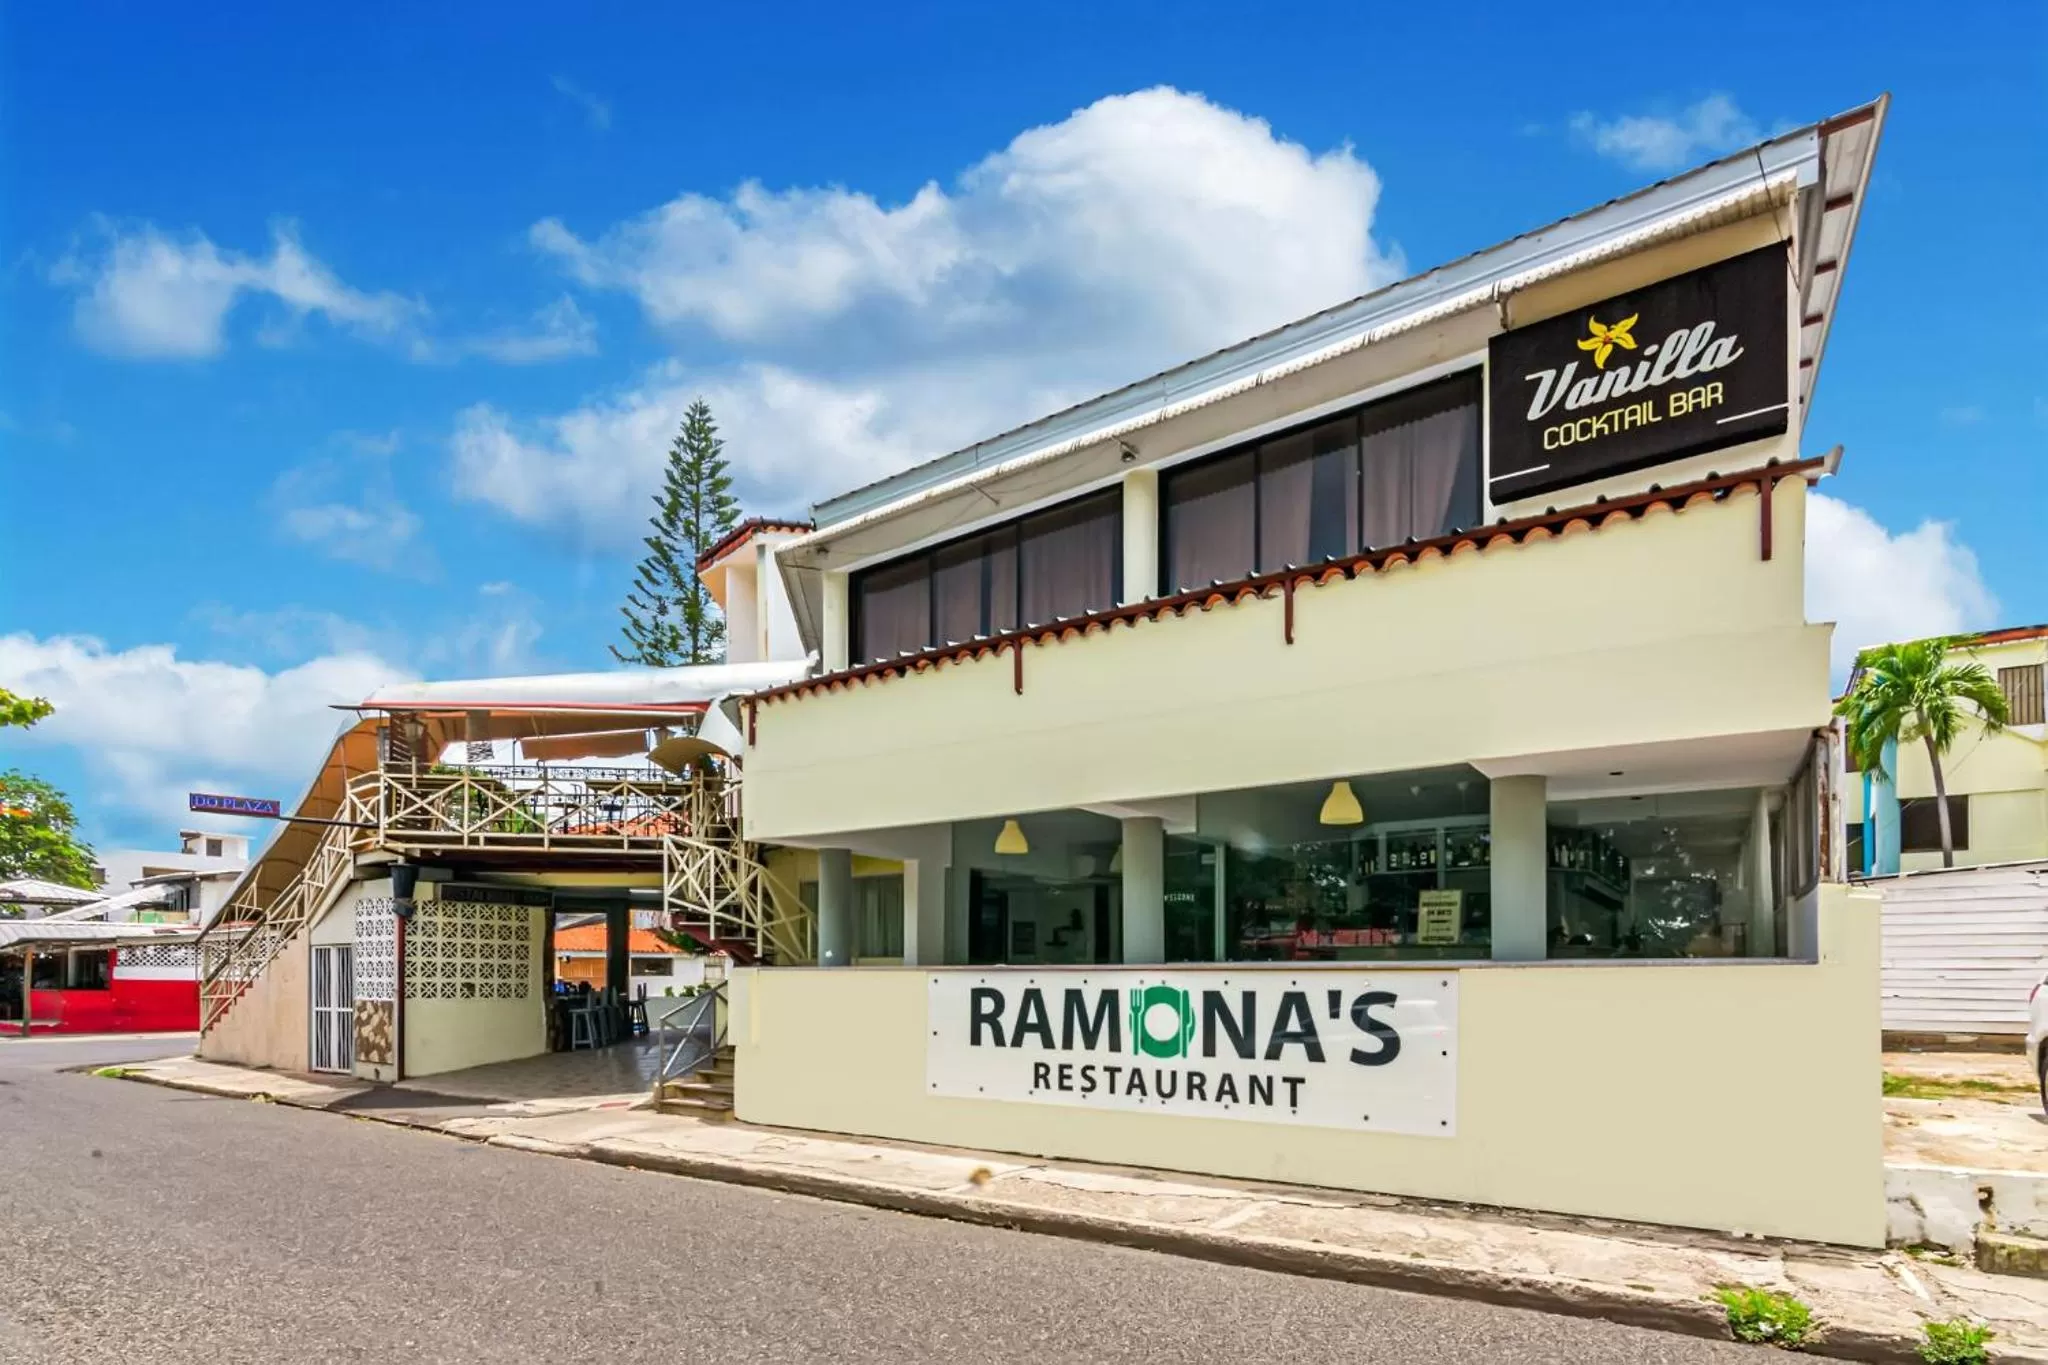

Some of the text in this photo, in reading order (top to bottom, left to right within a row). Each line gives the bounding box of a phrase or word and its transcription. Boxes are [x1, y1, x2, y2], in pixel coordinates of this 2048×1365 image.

[1525, 320, 1744, 421] Vanilla
[1543, 381, 1723, 450] COCKTAIL BAR
[223, 798, 275, 813] PLAZA
[970, 986, 1401, 1067] RAMONA'S
[1033, 1062, 1306, 1108] RESTAURANT
